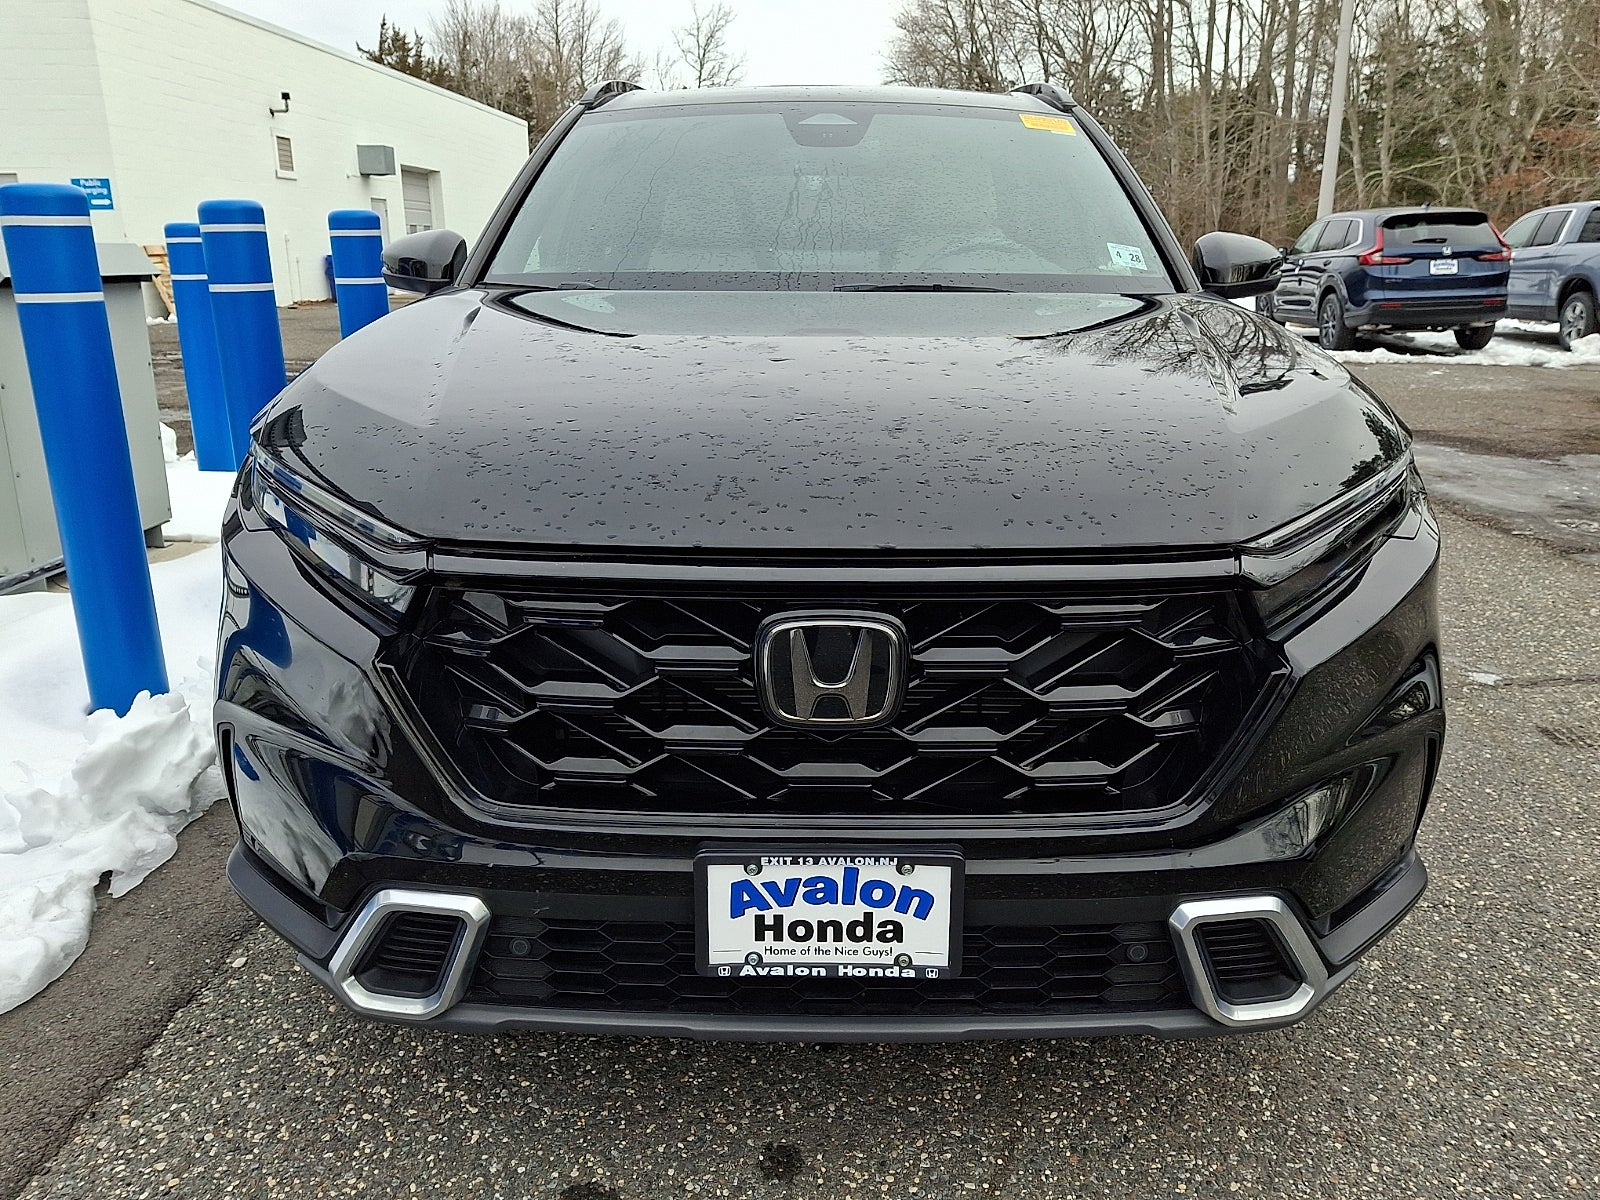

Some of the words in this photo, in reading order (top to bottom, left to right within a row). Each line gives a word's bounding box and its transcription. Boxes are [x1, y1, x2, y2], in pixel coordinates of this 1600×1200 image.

[1129, 253, 1142, 263] 28
[760, 856, 793, 866] EXIT
[798, 856, 814, 866] 13
[730, 866, 935, 921] Avalon
[754, 912, 904, 943] Honda
[764, 946, 797, 956] Home
[800, 946, 811, 956] of
[814, 946, 832, 956] the
[834, 946, 859, 956] Nice
[862, 946, 893, 958] Guys!
[739, 964, 827, 977] Avalon
[838, 964, 916, 978] Honda
